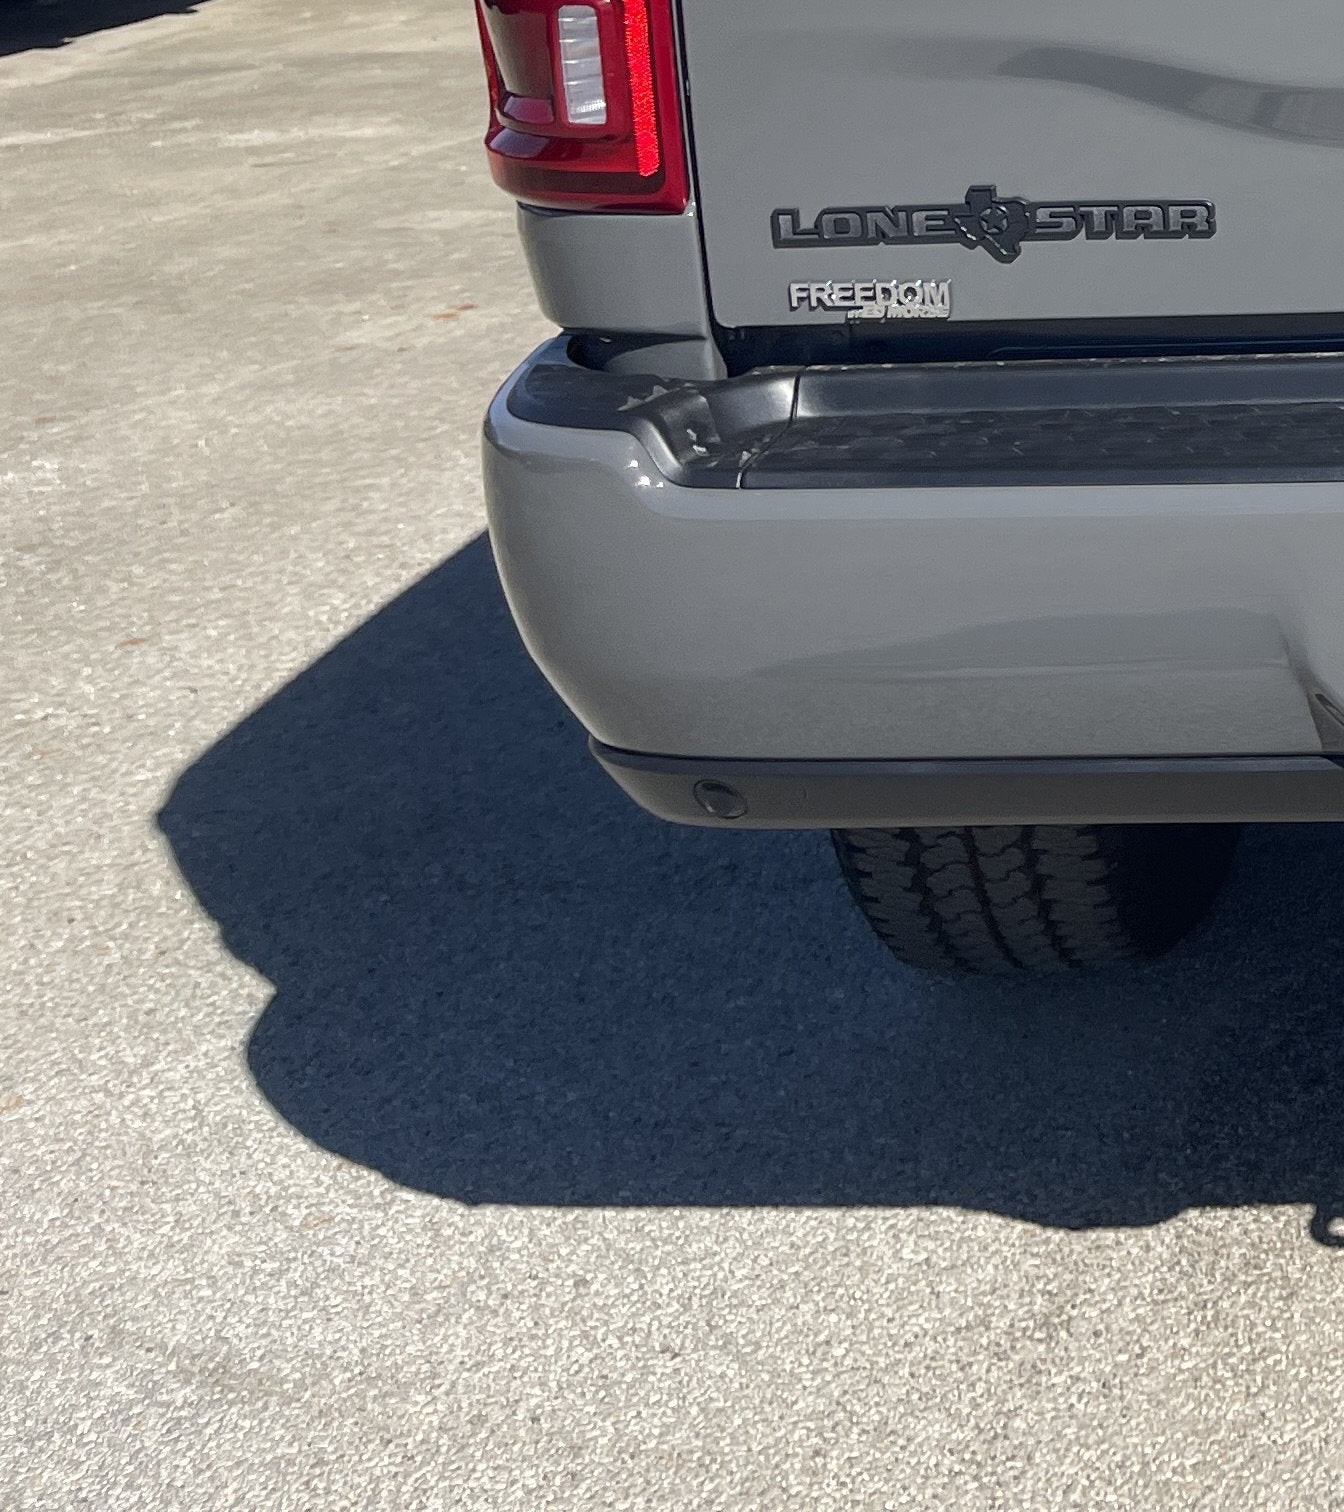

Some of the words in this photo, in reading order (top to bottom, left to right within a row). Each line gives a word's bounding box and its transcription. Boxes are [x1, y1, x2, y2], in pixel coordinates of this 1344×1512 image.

[772, 207, 957, 248] LONE
[1031, 199, 1216, 239] STAR
[790, 281, 950, 308] FREEDOM
